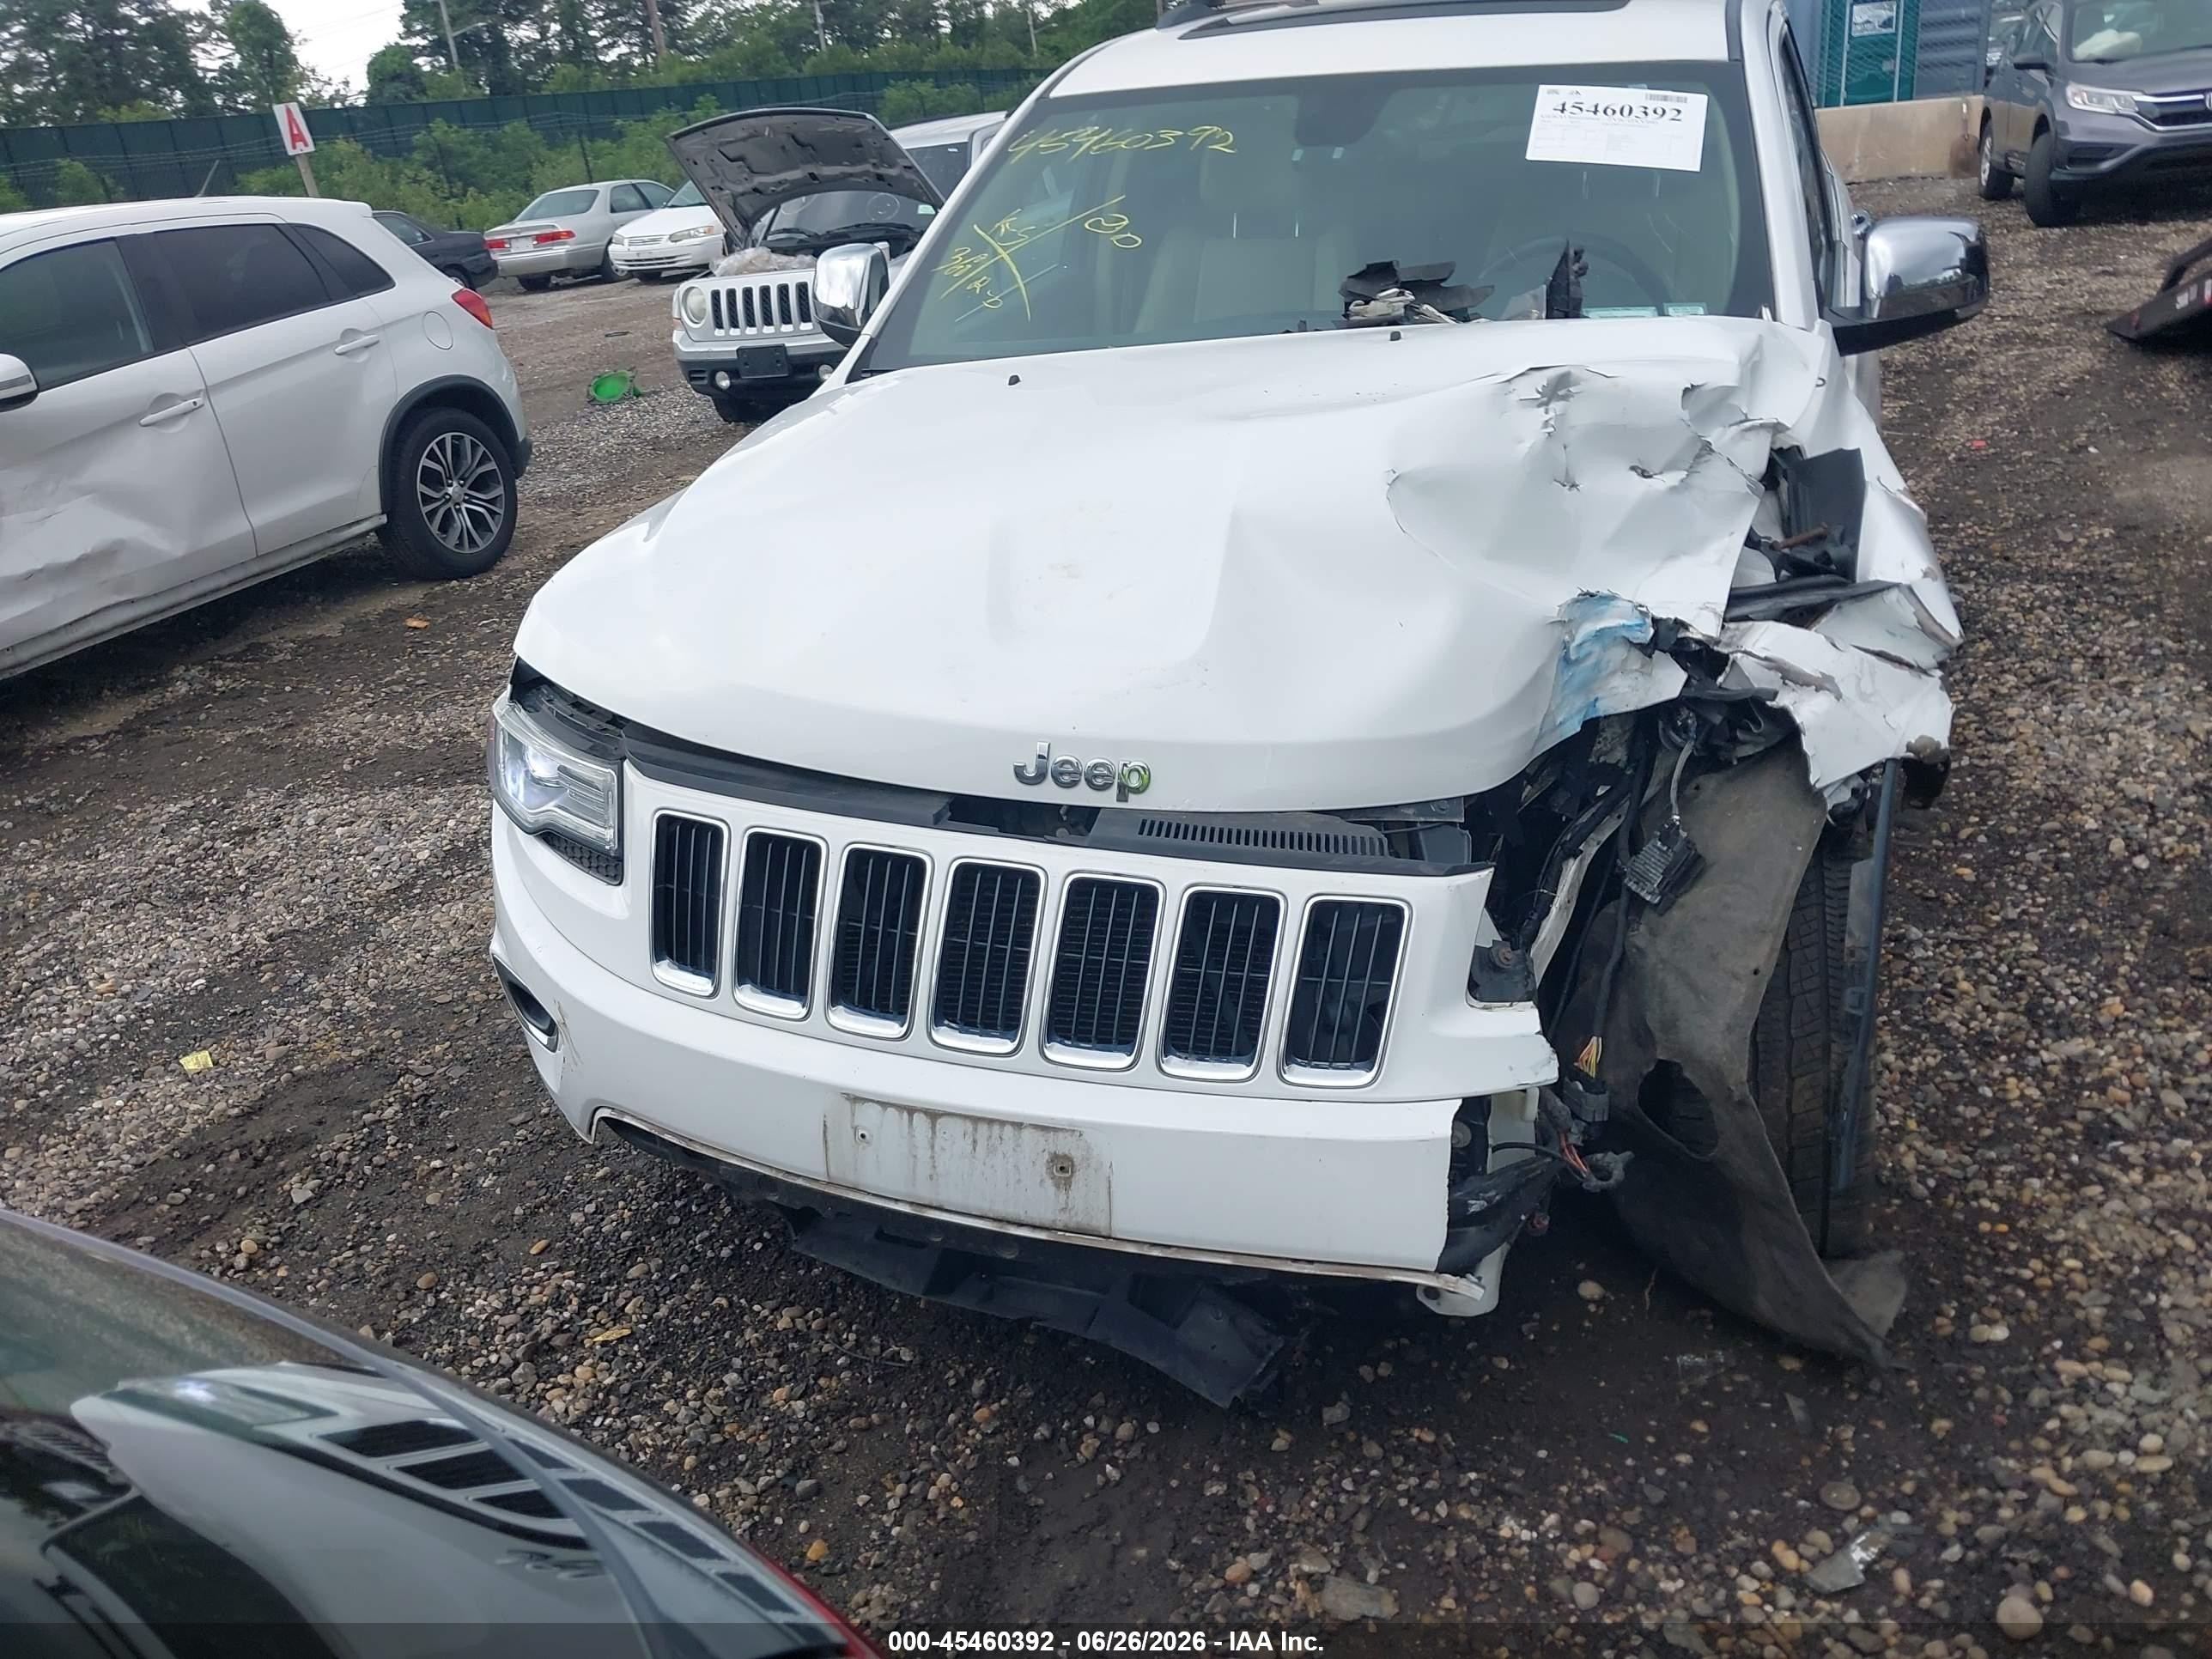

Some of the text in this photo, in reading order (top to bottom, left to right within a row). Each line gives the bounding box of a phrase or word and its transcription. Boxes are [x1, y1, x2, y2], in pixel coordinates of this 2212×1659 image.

[285, 104, 309, 150] A
[1552, 100, 1684, 123] 45460392
[1008, 125, 1237, 165] 45460392
[1013, 741, 1152, 802] Jeep
